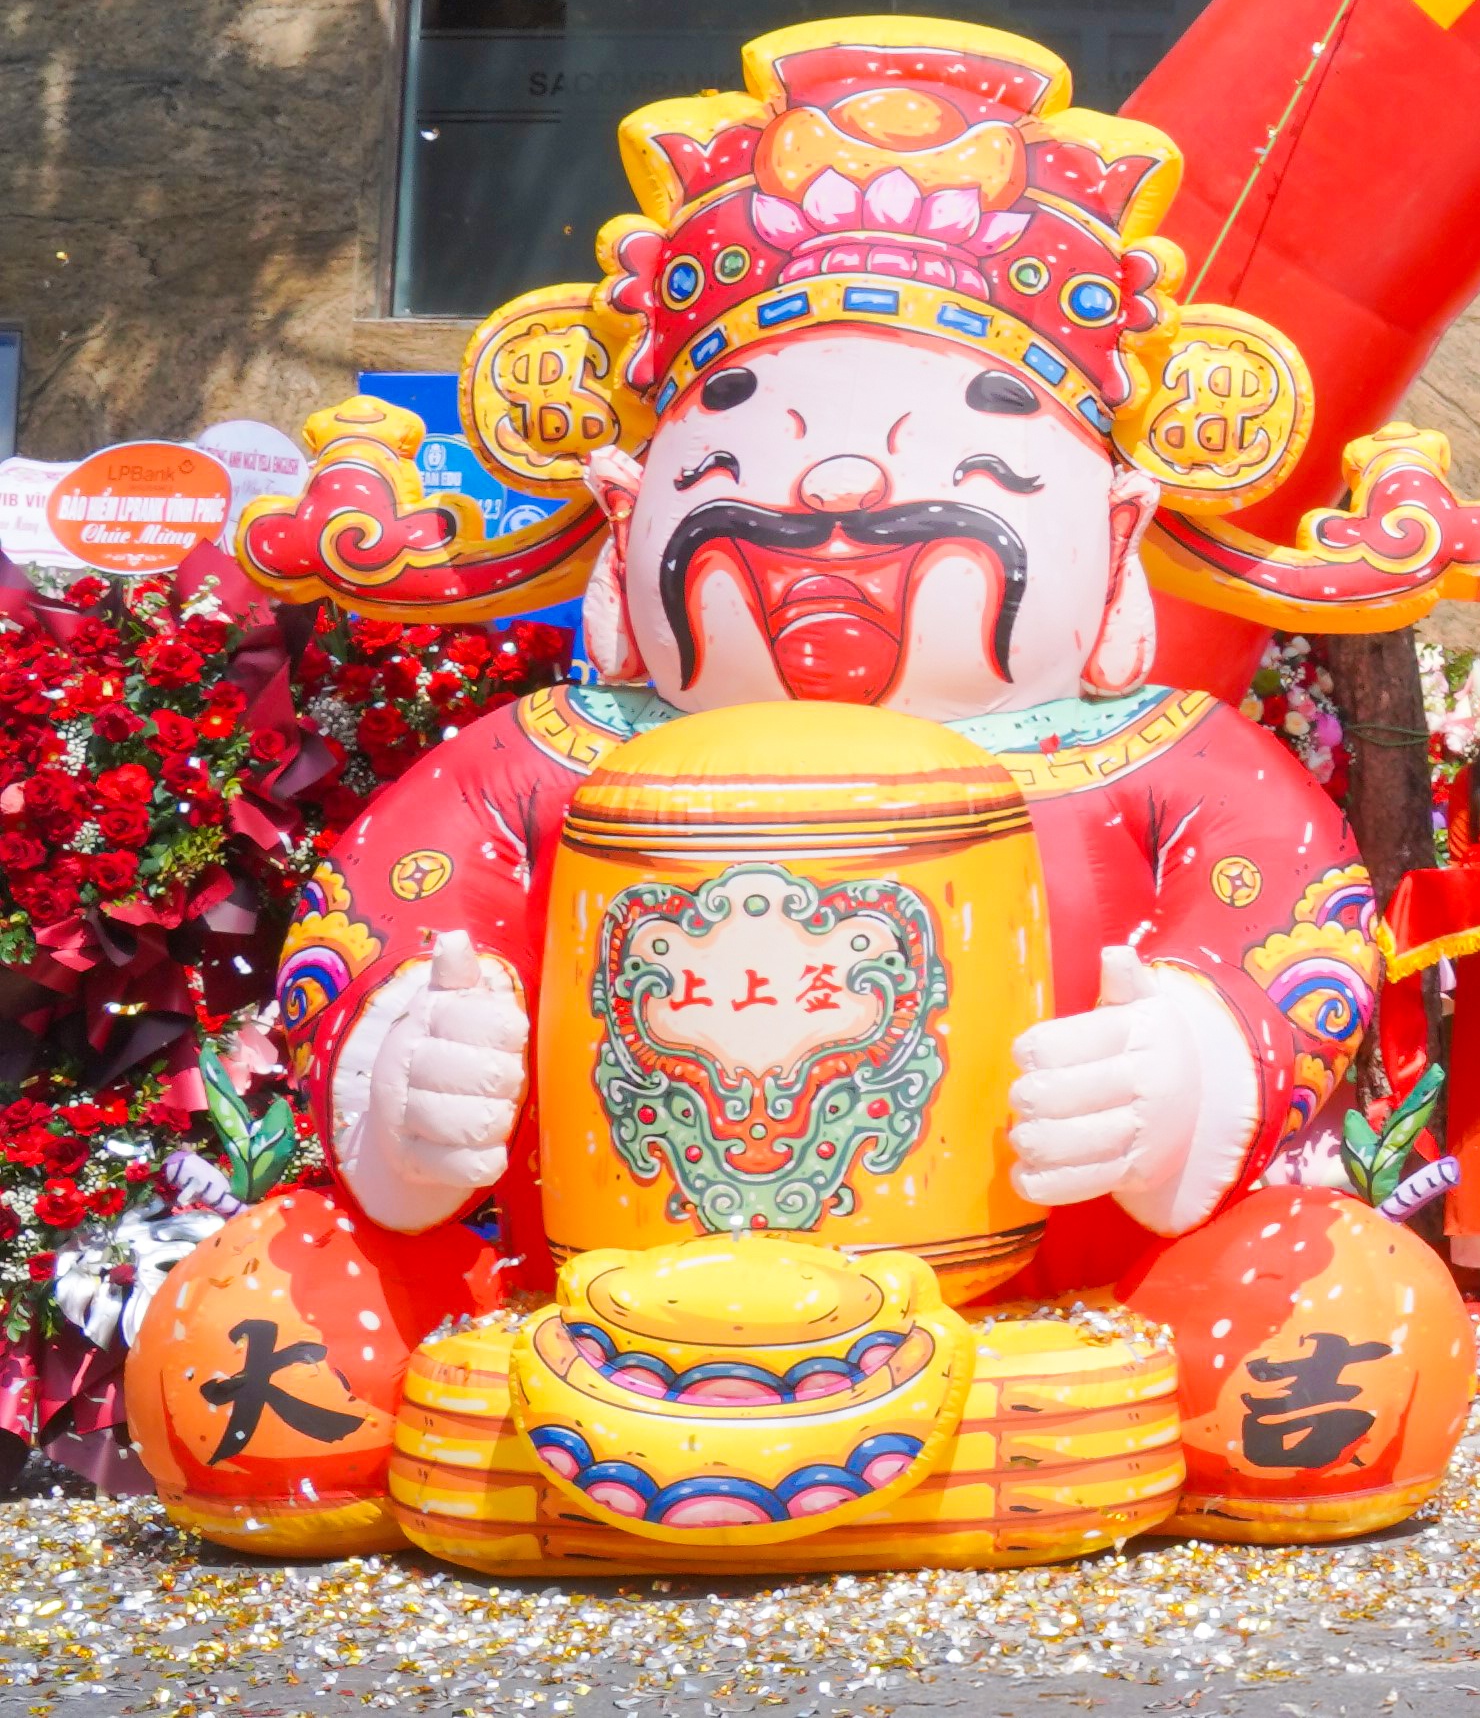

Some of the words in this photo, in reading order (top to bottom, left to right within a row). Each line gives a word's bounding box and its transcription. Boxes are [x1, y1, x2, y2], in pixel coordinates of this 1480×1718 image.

[107, 464, 175, 482] LPBank
[58, 488, 87, 521] BẢO
[87, 487, 118, 522] HIỂM
[118, 496, 165, 522] LPBANK
[166, 492, 196, 523] VĨNH
[196, 493, 226, 523] PHÚC
[80, 523, 132, 544] Chúc
[134, 523, 197, 550] Mừng
[201, 1319, 367, 1465] 大
[1242, 1333, 1395, 1471] 吉
